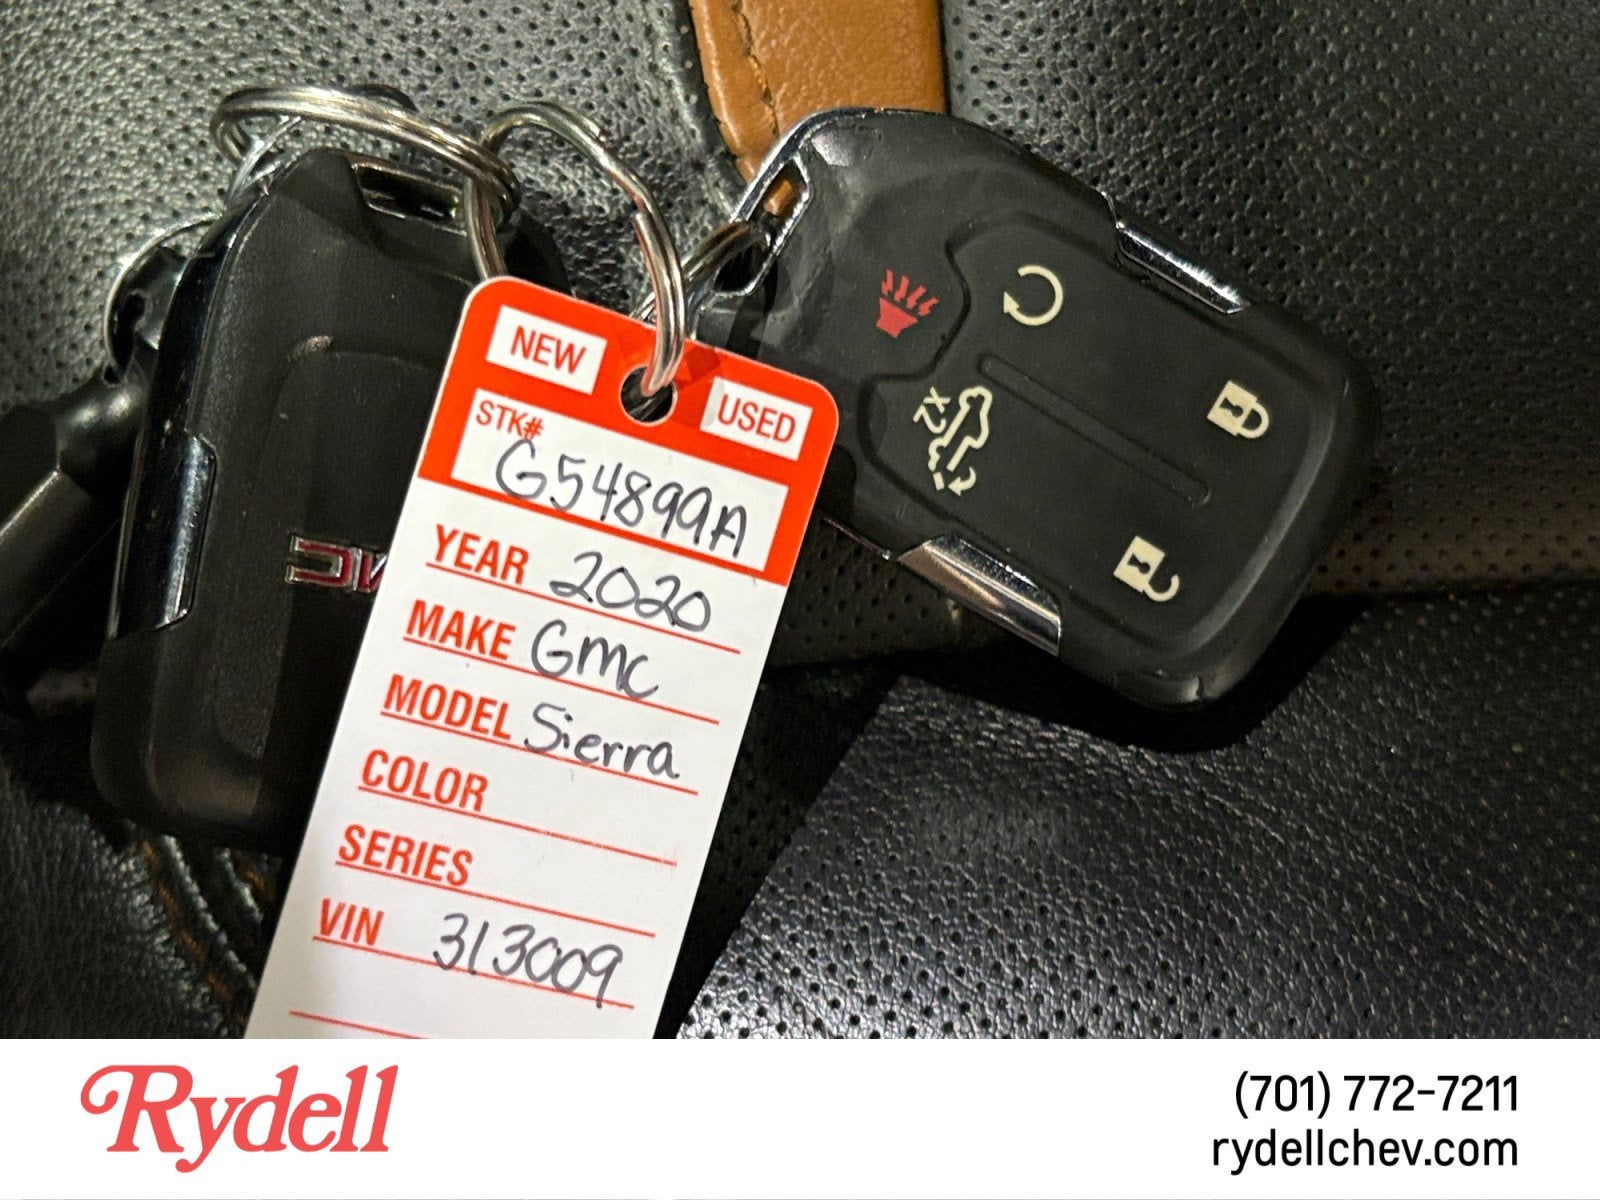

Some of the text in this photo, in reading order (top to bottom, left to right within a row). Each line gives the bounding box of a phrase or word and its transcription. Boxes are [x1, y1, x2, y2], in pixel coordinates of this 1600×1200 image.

[510, 326, 587, 374] NEW
[475, 400, 544, 441] STK#
[717, 394, 796, 443] USED
[495, 438, 747, 559] G54899A
[434, 524, 529, 585] YEAR
[549, 551, 711, 632] 2020
[406, 600, 516, 660] MAKE
[383, 675, 512, 741] MODEL
[523, 702, 681, 779] Sierra
[361, 749, 489, 812] COLOR
[337, 824, 473, 887] SERIES
[319, 898, 385, 947] VIN
[432, 912, 625, 1009] 313009
